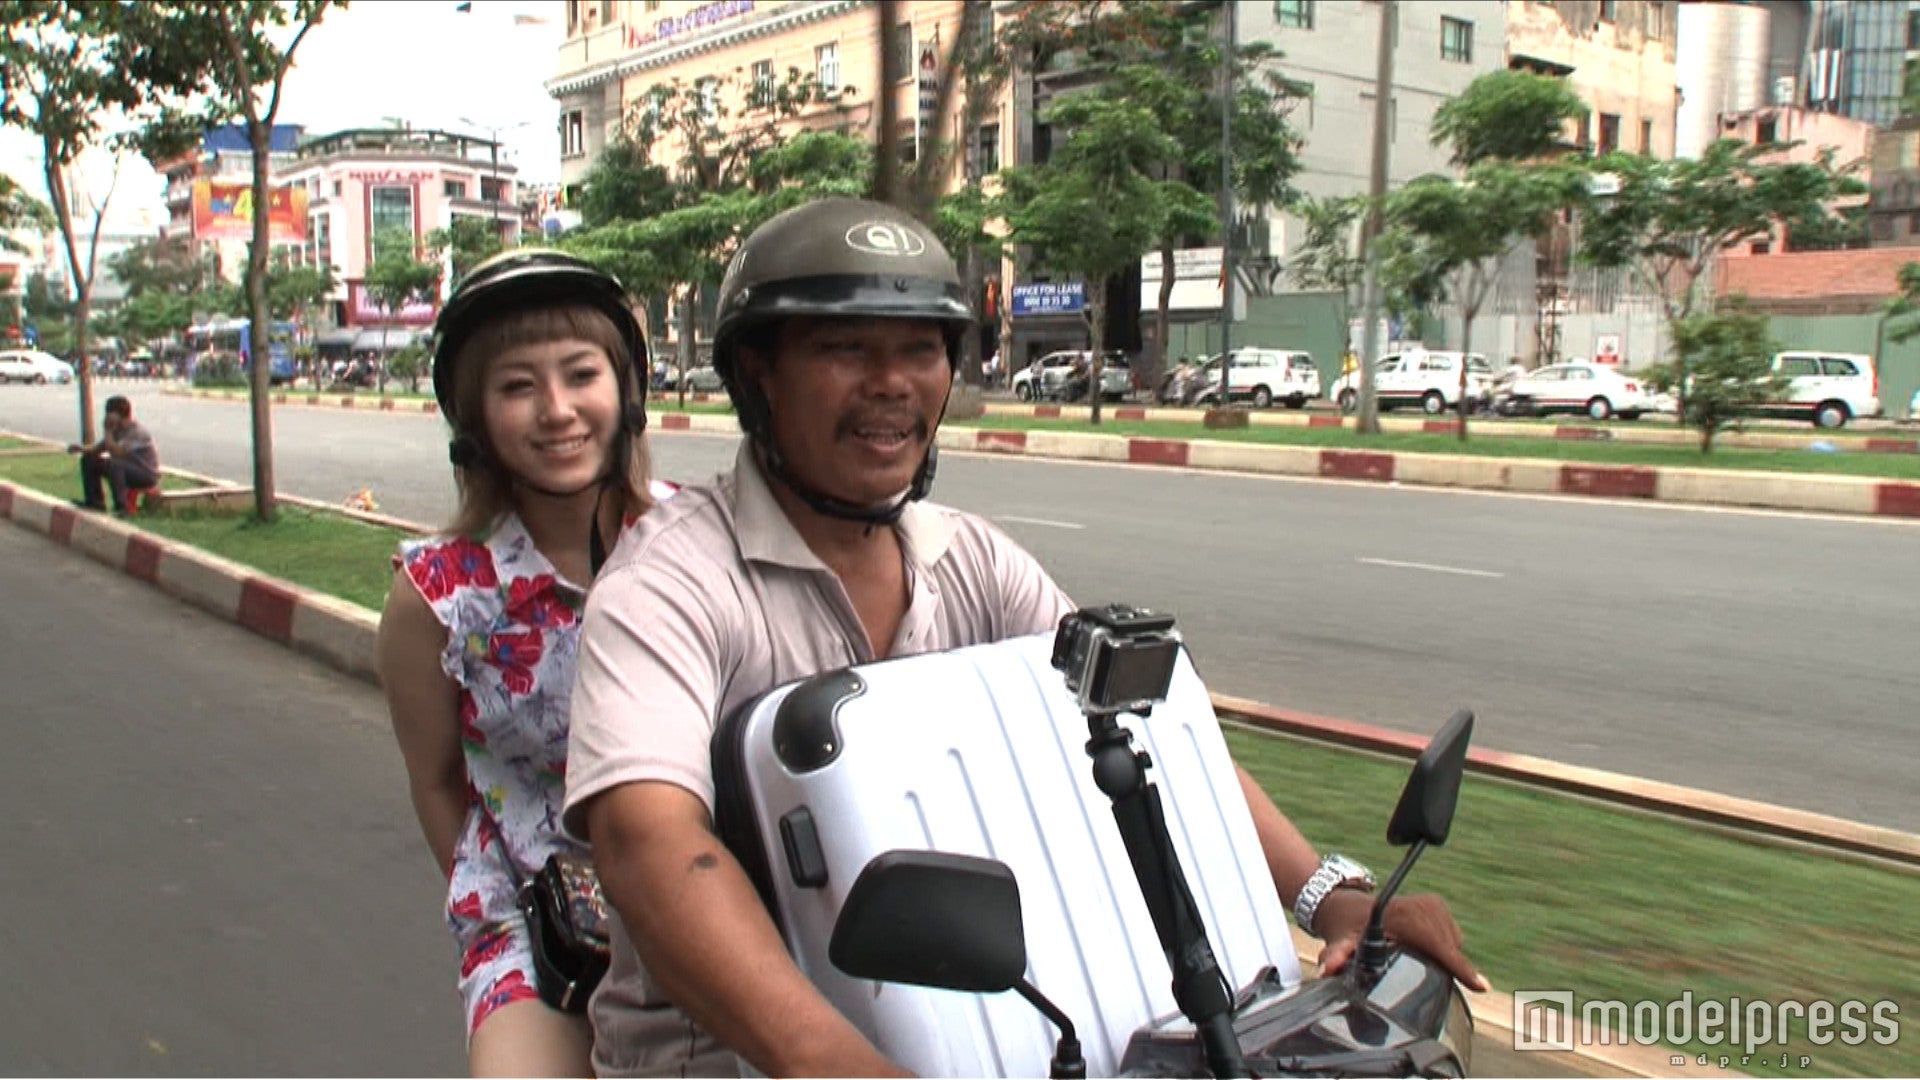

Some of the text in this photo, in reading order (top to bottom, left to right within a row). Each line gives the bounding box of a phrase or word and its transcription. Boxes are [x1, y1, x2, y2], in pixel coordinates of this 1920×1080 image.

[1013, 282, 1083, 298] OFFICE FOR LEASE
